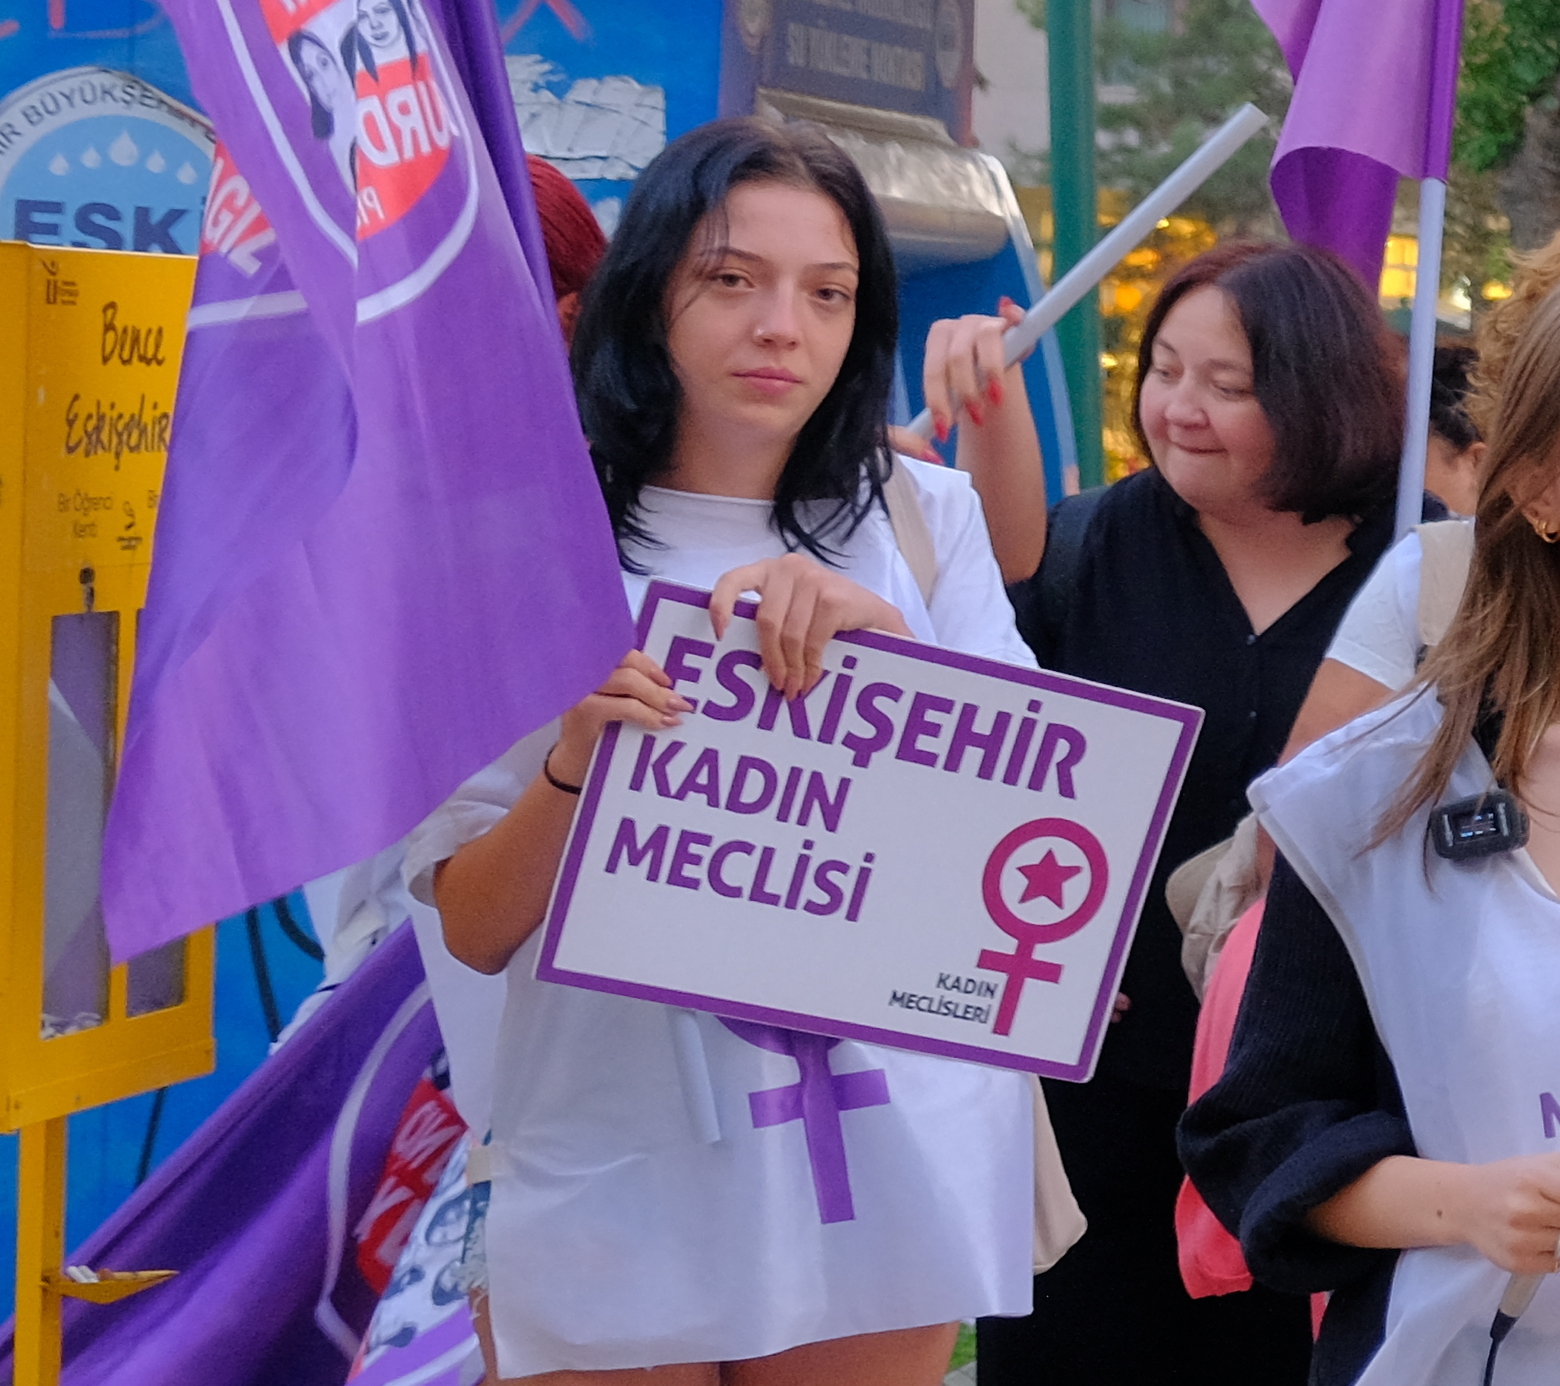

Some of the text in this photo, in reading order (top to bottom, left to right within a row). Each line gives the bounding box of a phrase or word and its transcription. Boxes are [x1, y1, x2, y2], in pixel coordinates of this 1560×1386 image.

[662, 634, 1089, 802] ESKİŞEHİR
[627, 733, 853, 833] KADIN
[603, 816, 877, 924] MECLİSİ
[888, 989, 992, 1026] MECLİSLERİ
[935, 971, 999, 1002] KADIN
